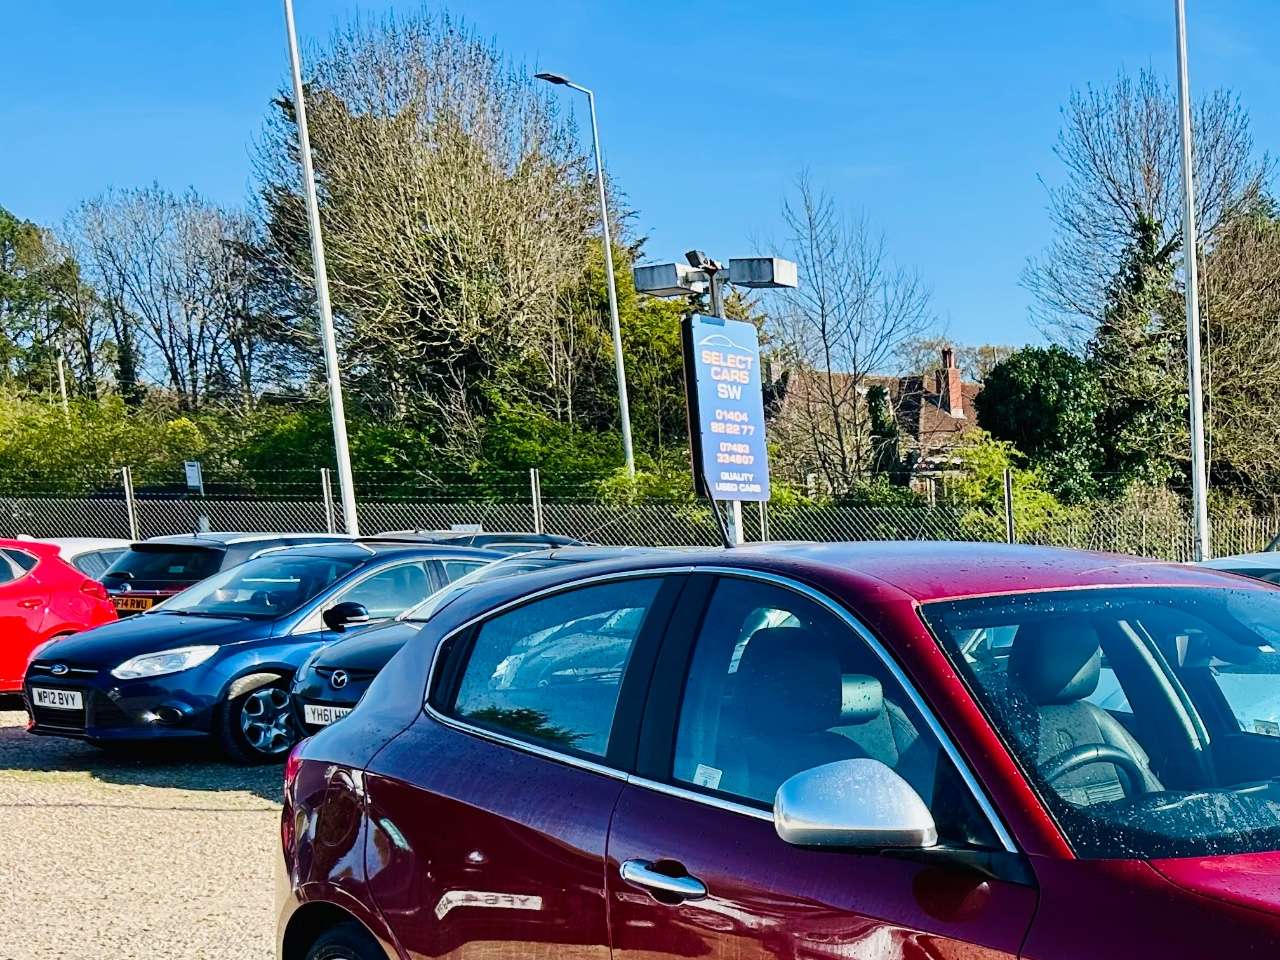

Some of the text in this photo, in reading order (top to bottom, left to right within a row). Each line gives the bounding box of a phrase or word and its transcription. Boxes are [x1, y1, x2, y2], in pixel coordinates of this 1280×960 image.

[702, 350, 753, 370] SELECT
[711, 366, 750, 385] CARS
[717, 383, 742, 401] SW
[715, 409, 749, 422] 01404
[726, 423, 740, 435] 22
[741, 425, 755, 436] 77
[720, 472, 754, 482] QUALITY
[715, 482, 761, 493] USED CARS
[37, 690, 76, 706] WP12 BVY
[310, 707, 333, 723] YH61
